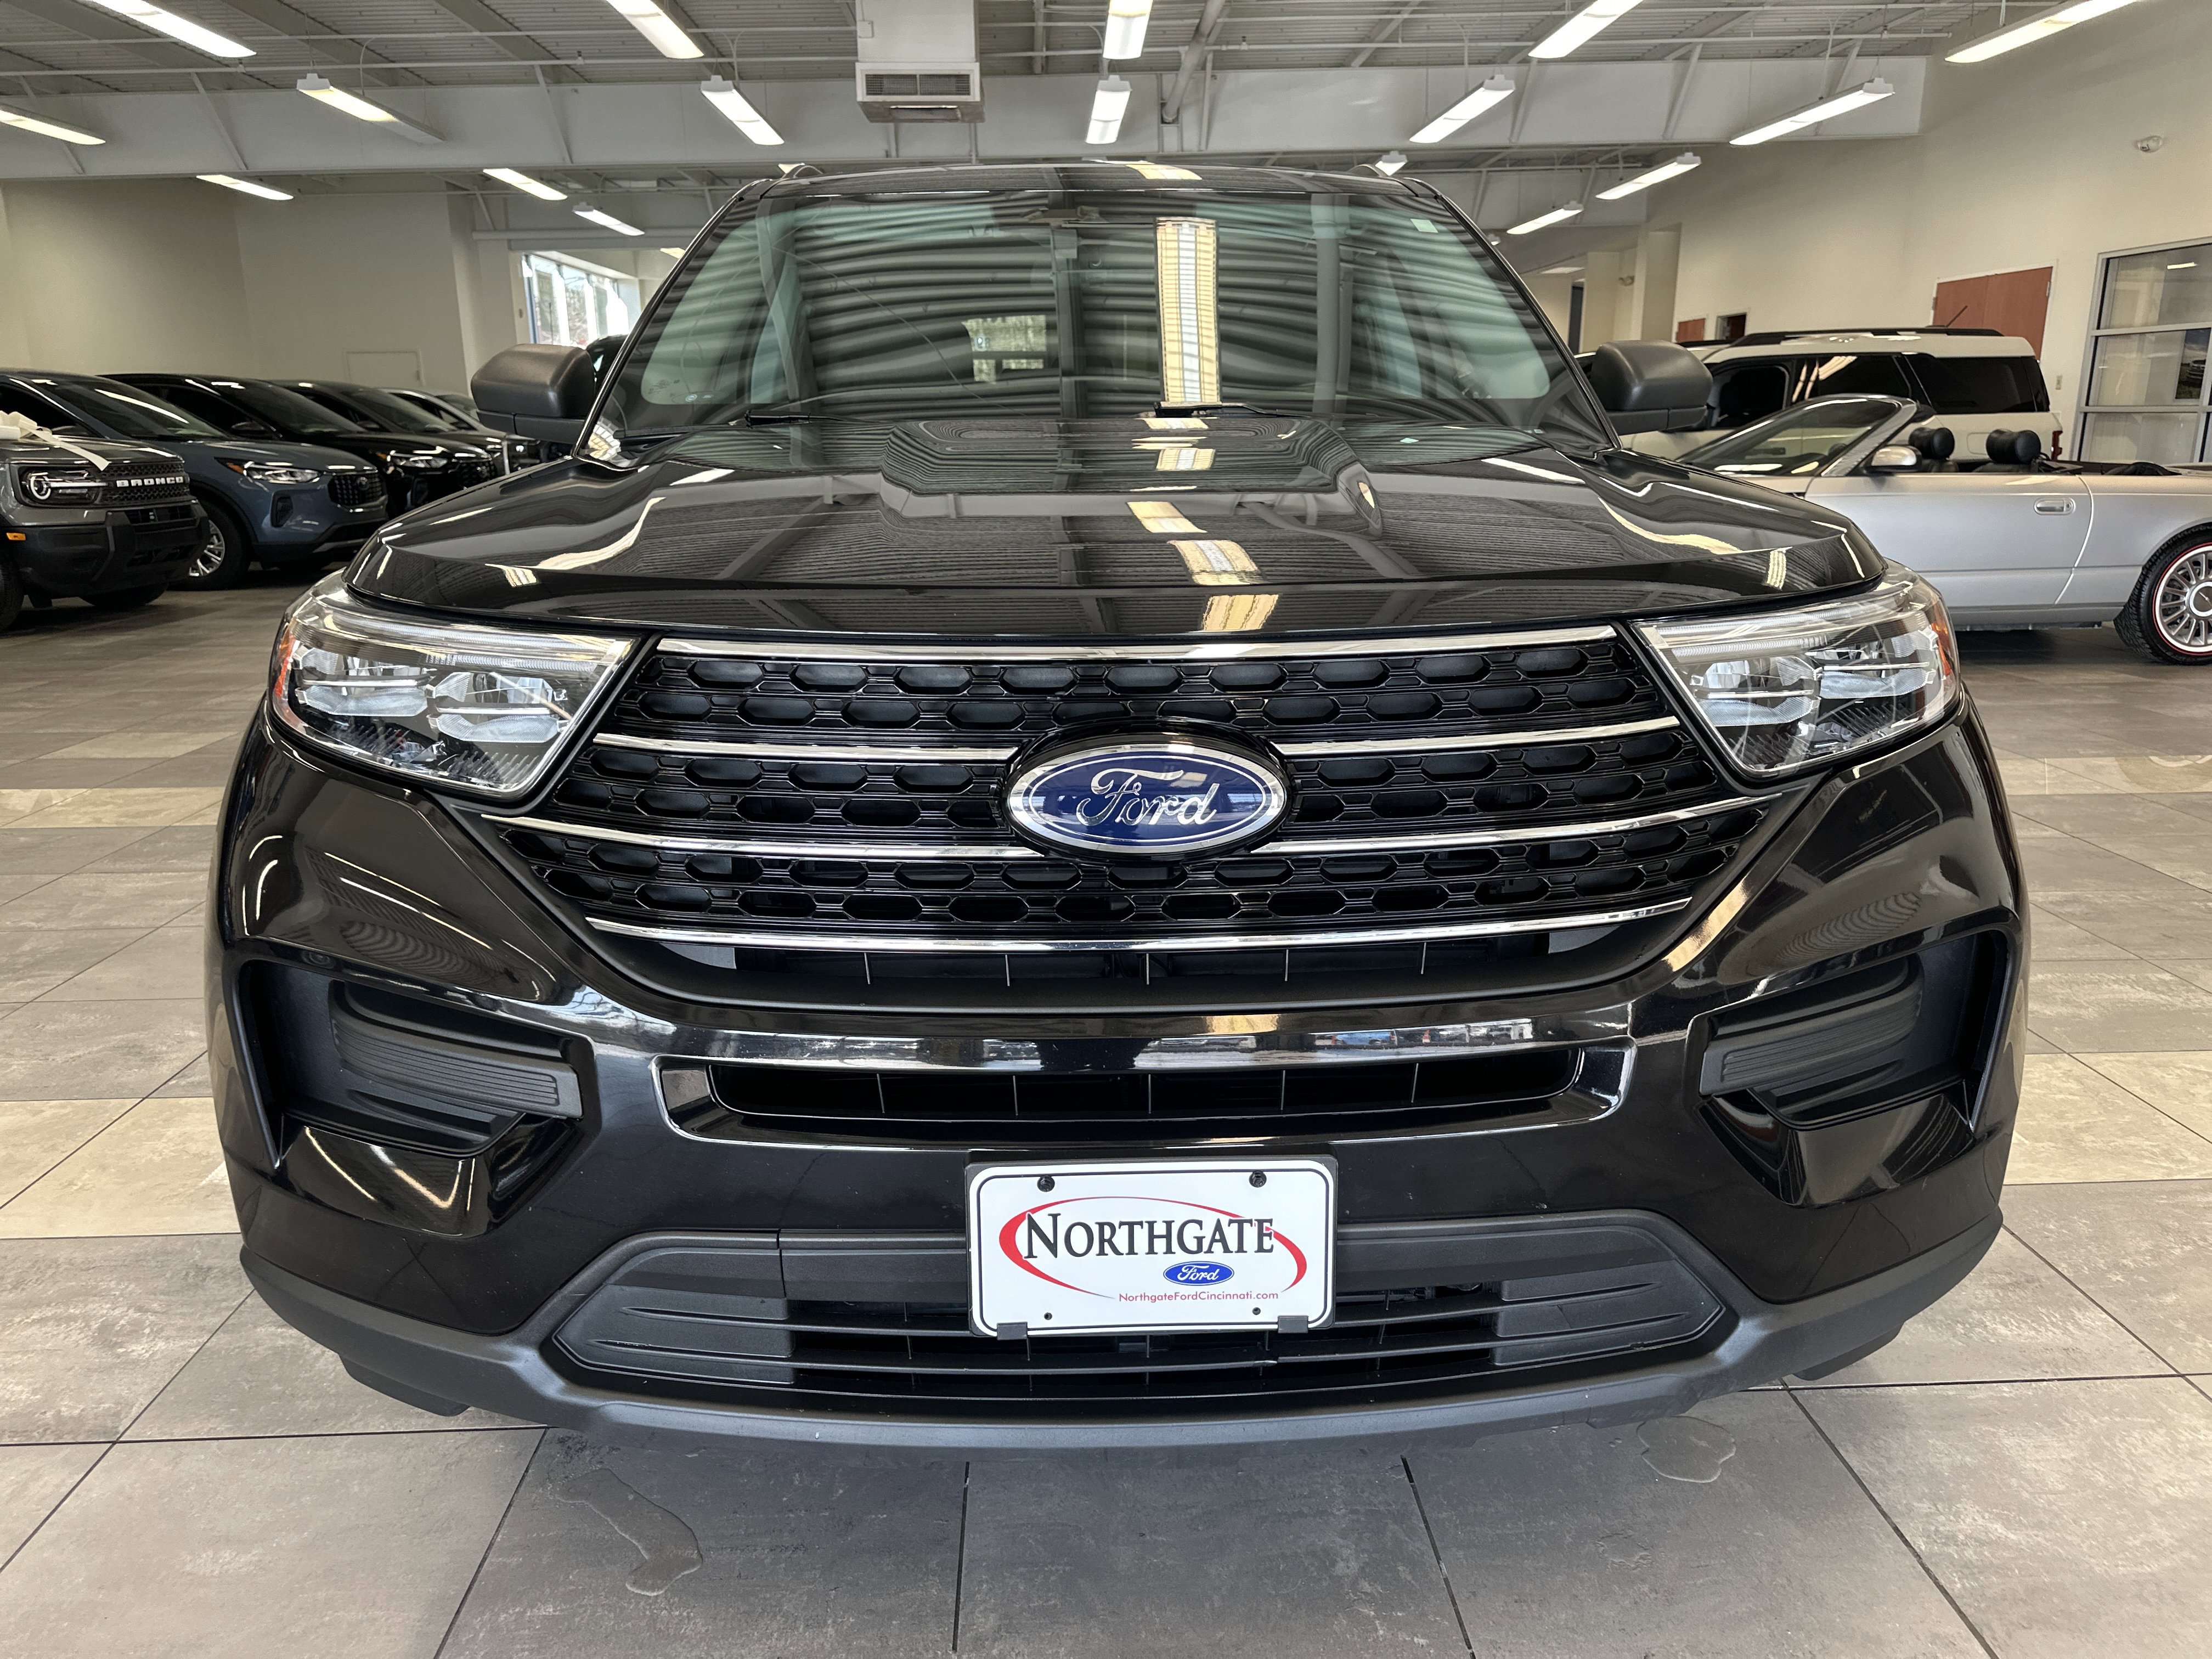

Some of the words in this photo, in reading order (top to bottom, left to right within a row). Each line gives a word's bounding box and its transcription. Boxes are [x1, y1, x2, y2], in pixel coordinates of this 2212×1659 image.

[116, 476, 184, 488] BRONCO
[1076, 768, 1220, 826] Ford
[1023, 1212, 1274, 1259] NORTHGATE
[1177, 1264, 1221, 1282] Ford
[1119, 1290, 1278, 1303] NorthgateFordCincinnati.com
